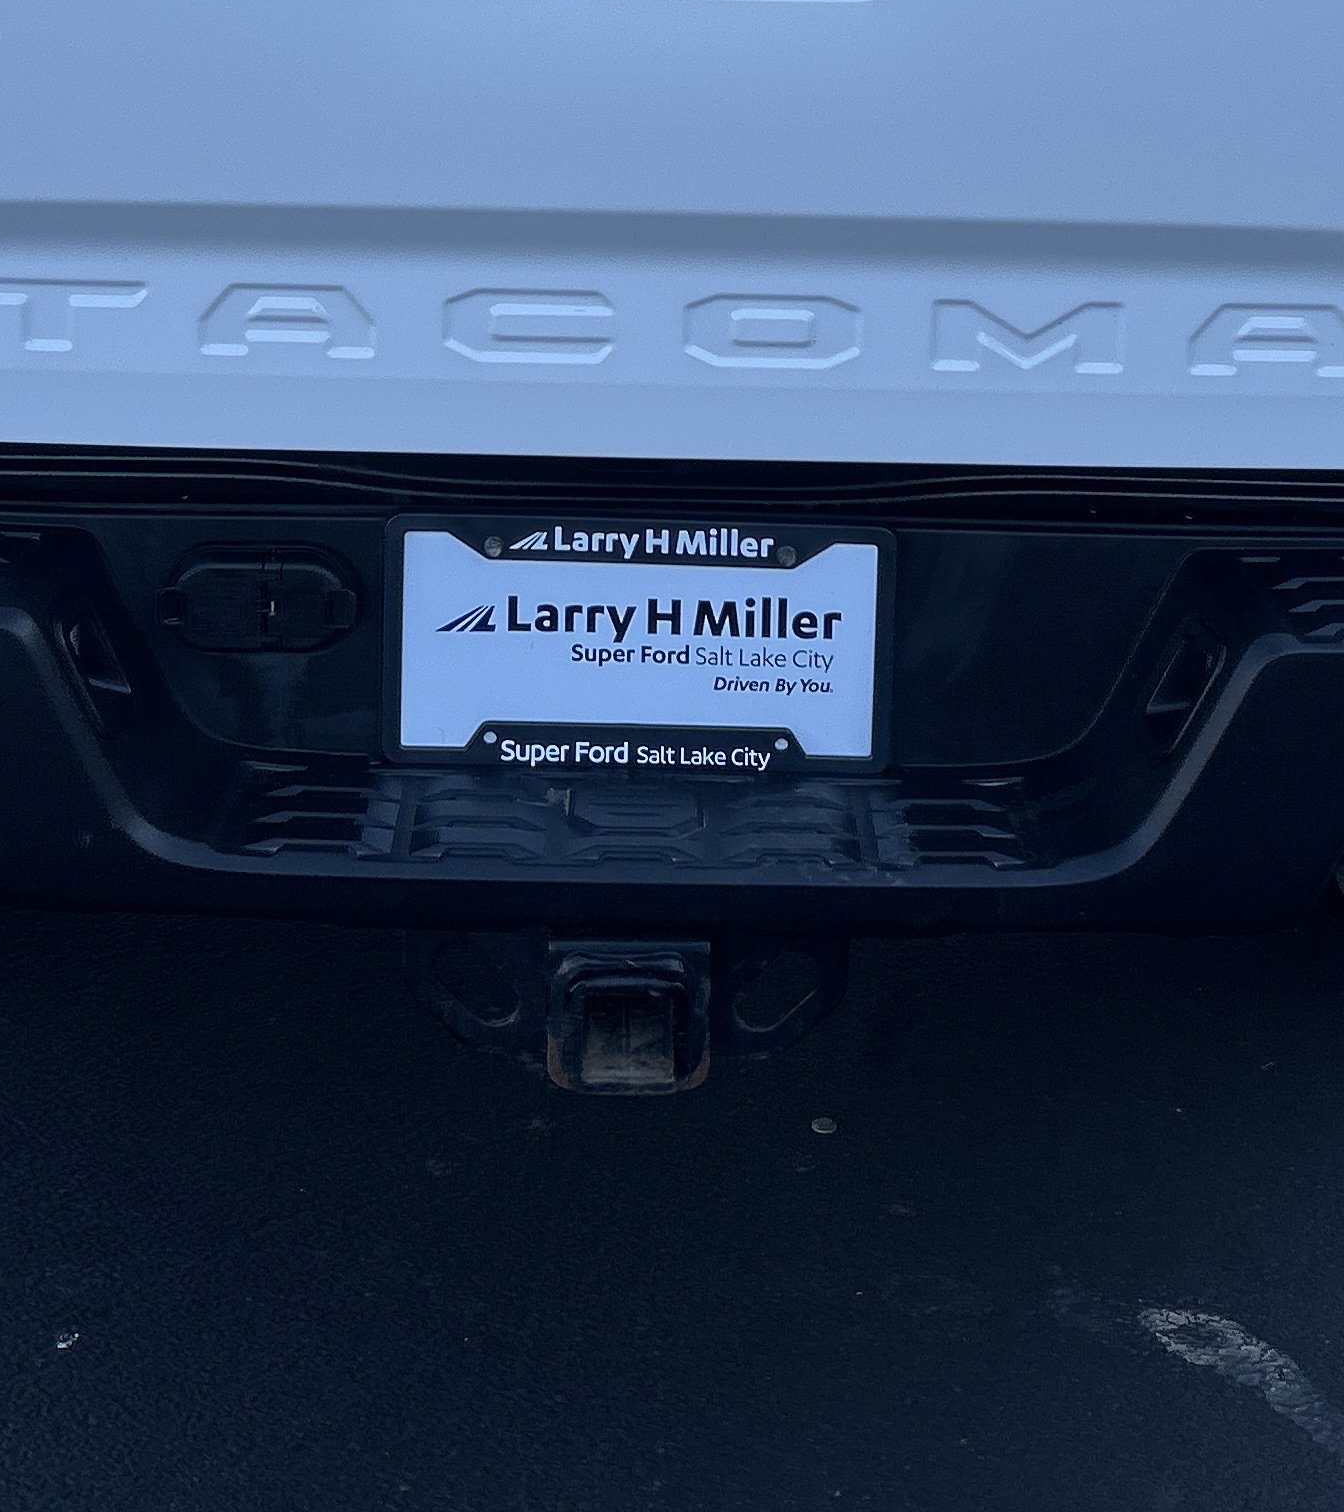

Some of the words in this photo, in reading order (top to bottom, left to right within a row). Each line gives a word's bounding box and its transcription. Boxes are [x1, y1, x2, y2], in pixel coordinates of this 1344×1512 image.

[554, 526, 640, 559] Larry
[645, 528, 670, 555] H
[675, 528, 775, 558] Miller
[507, 595, 637, 643] Larry
[647, 598, 682, 635] H
[693, 597, 843, 640] Miller
[571, 644, 636, 667] Super
[640, 645, 690, 665] Ford
[695, 646, 734, 667] Salt
[739, 647, 787, 668] Lake
[792, 649, 834, 674] City
[713, 675, 770, 693] Driven
[775, 678, 797, 696] By
[500, 739, 570, 767] Super
[574, 741, 629, 764] Ford
[636, 745, 676, 766] Salt
[680, 746, 727, 766] Lake
[730, 746, 771, 771] City
